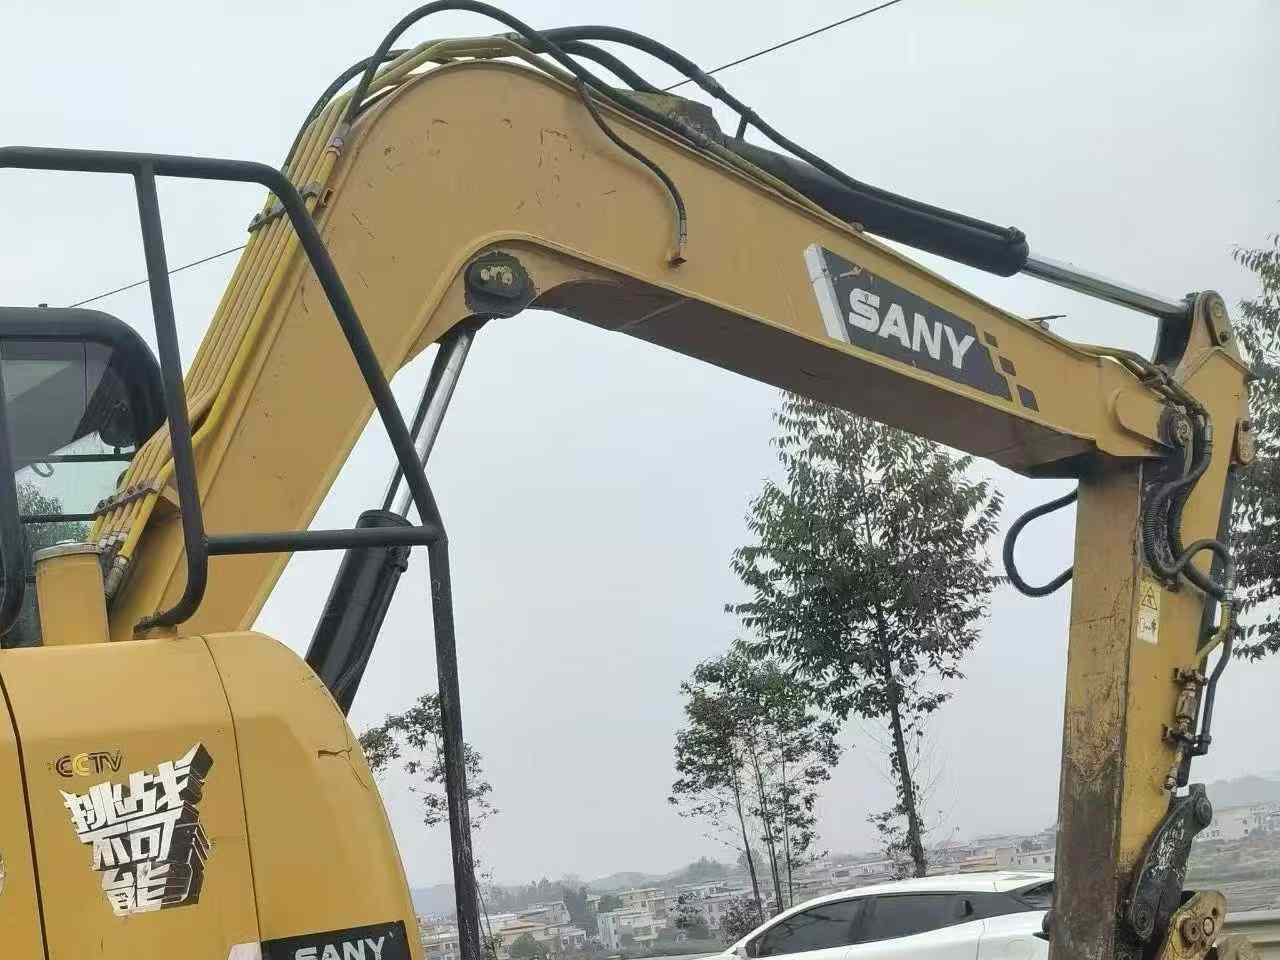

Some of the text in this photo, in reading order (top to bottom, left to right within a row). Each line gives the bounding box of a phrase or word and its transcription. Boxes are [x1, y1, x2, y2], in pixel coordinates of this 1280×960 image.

[848, 288, 976, 369] SANY
[56, 752, 122, 777] CCTV
[58, 743, 202, 832] 挑战
